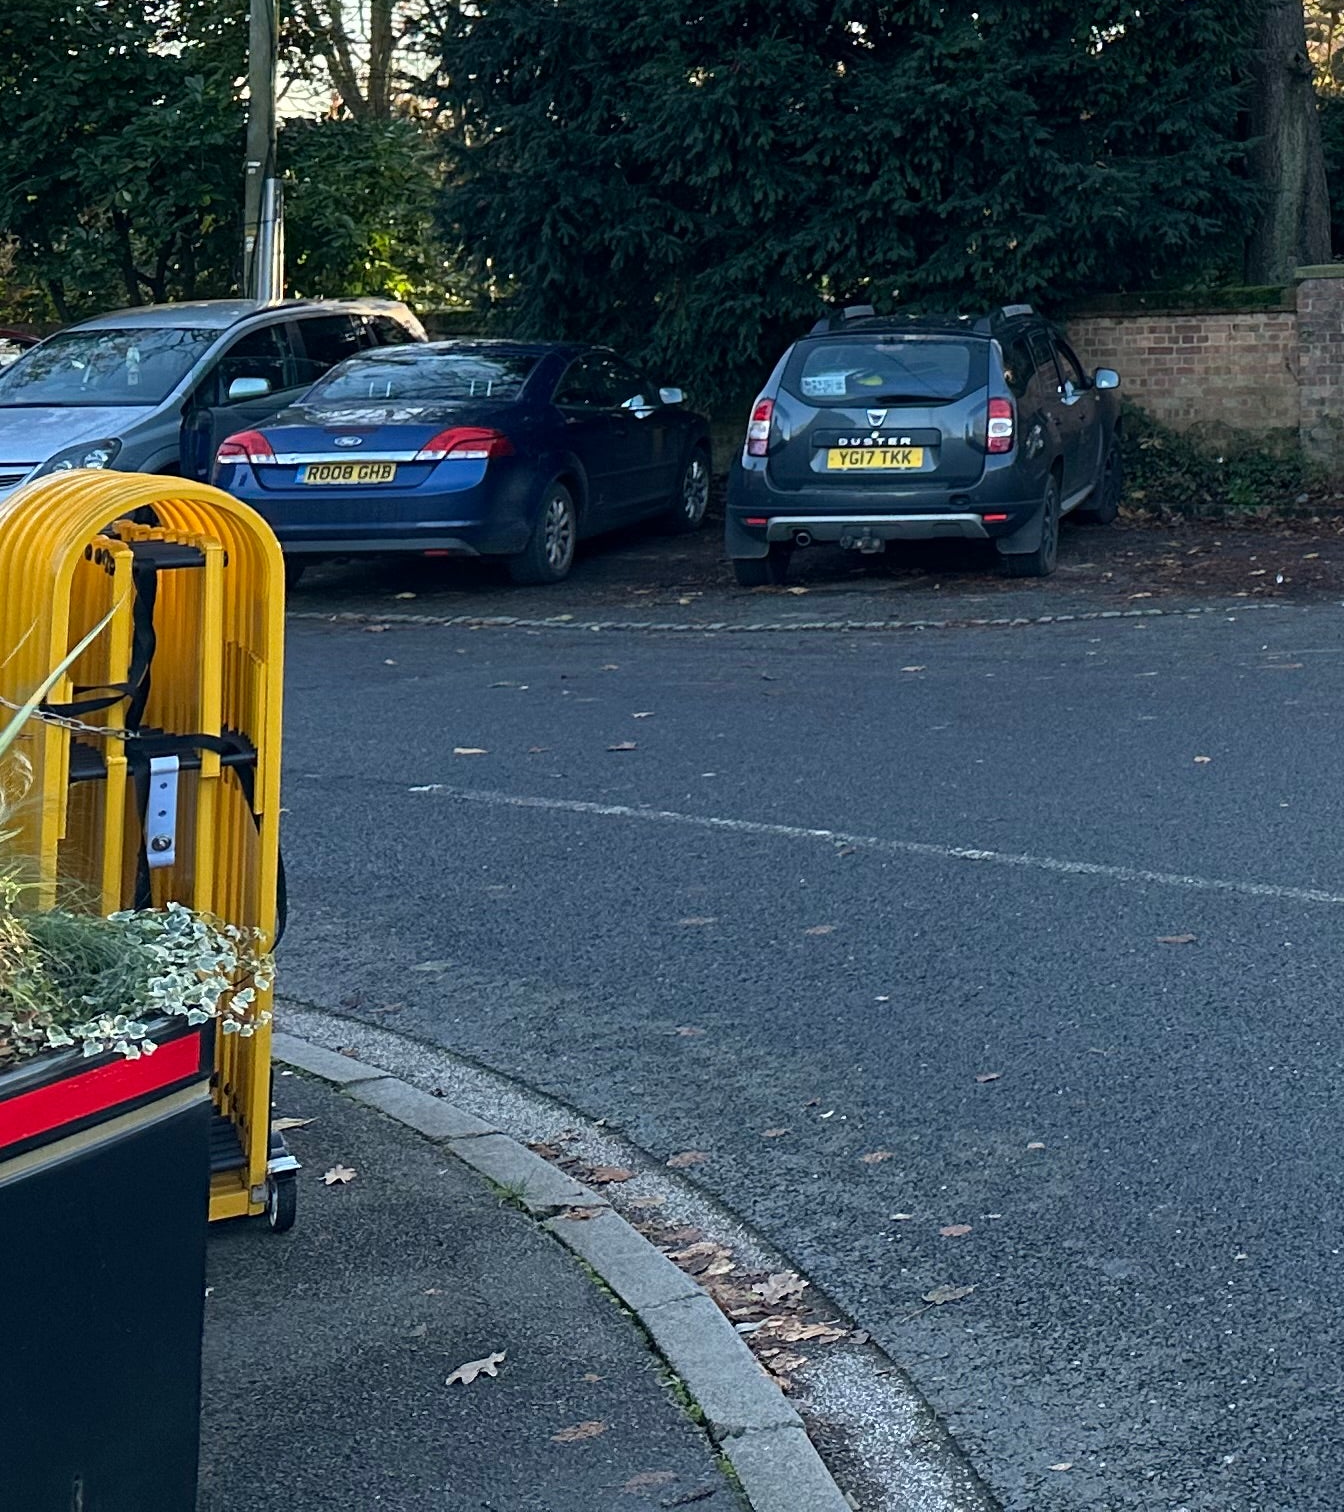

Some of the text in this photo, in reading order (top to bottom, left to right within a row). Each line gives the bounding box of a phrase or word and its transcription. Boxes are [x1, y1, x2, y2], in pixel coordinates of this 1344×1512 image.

[838, 437, 912, 446] DUSTER
[839, 450, 912, 465] YG17 TKK
[358, 464, 392, 479] GHB
